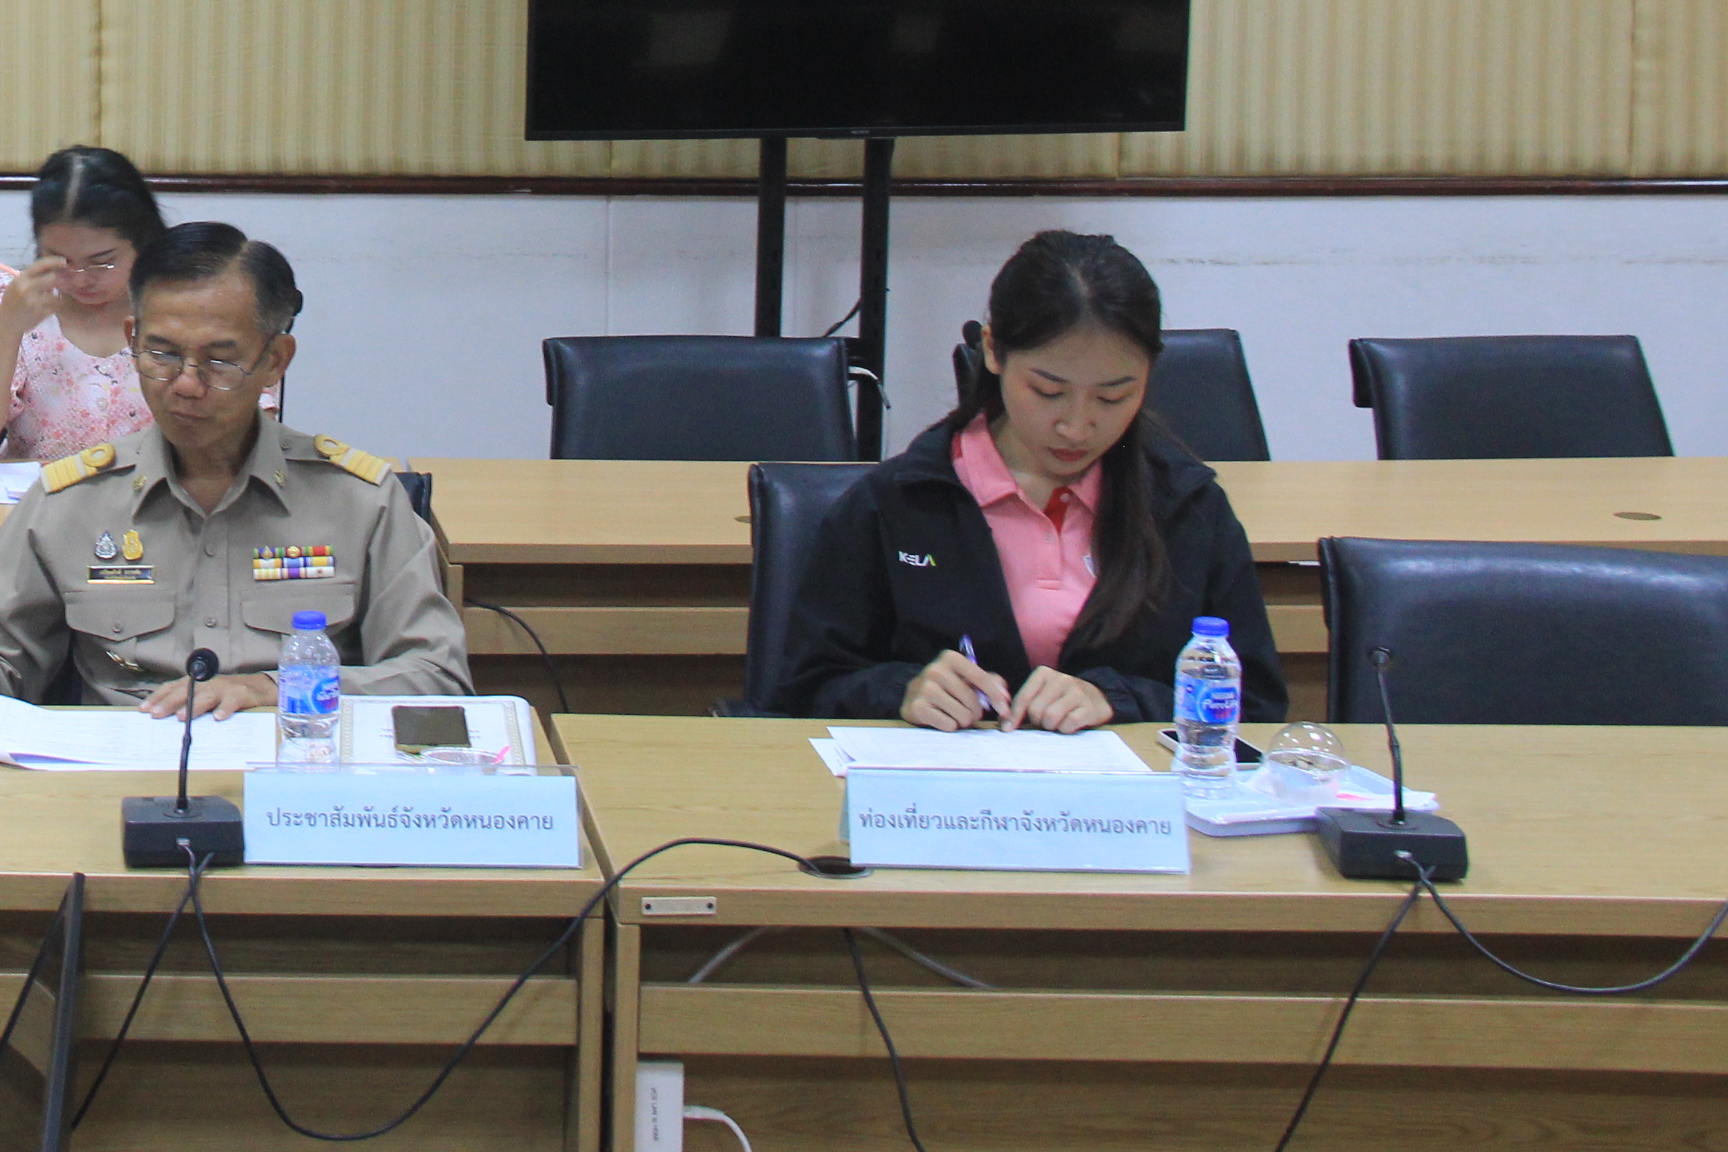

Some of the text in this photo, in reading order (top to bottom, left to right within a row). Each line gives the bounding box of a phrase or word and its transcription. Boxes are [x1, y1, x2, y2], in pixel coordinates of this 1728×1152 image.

[265, 805, 555, 830] ประชาสัมพันธ์จังหวัดหนองคาย
[858, 802, 1172, 835] ท่องเที่ยวและกีฬาจังหวัดหนองคาย
